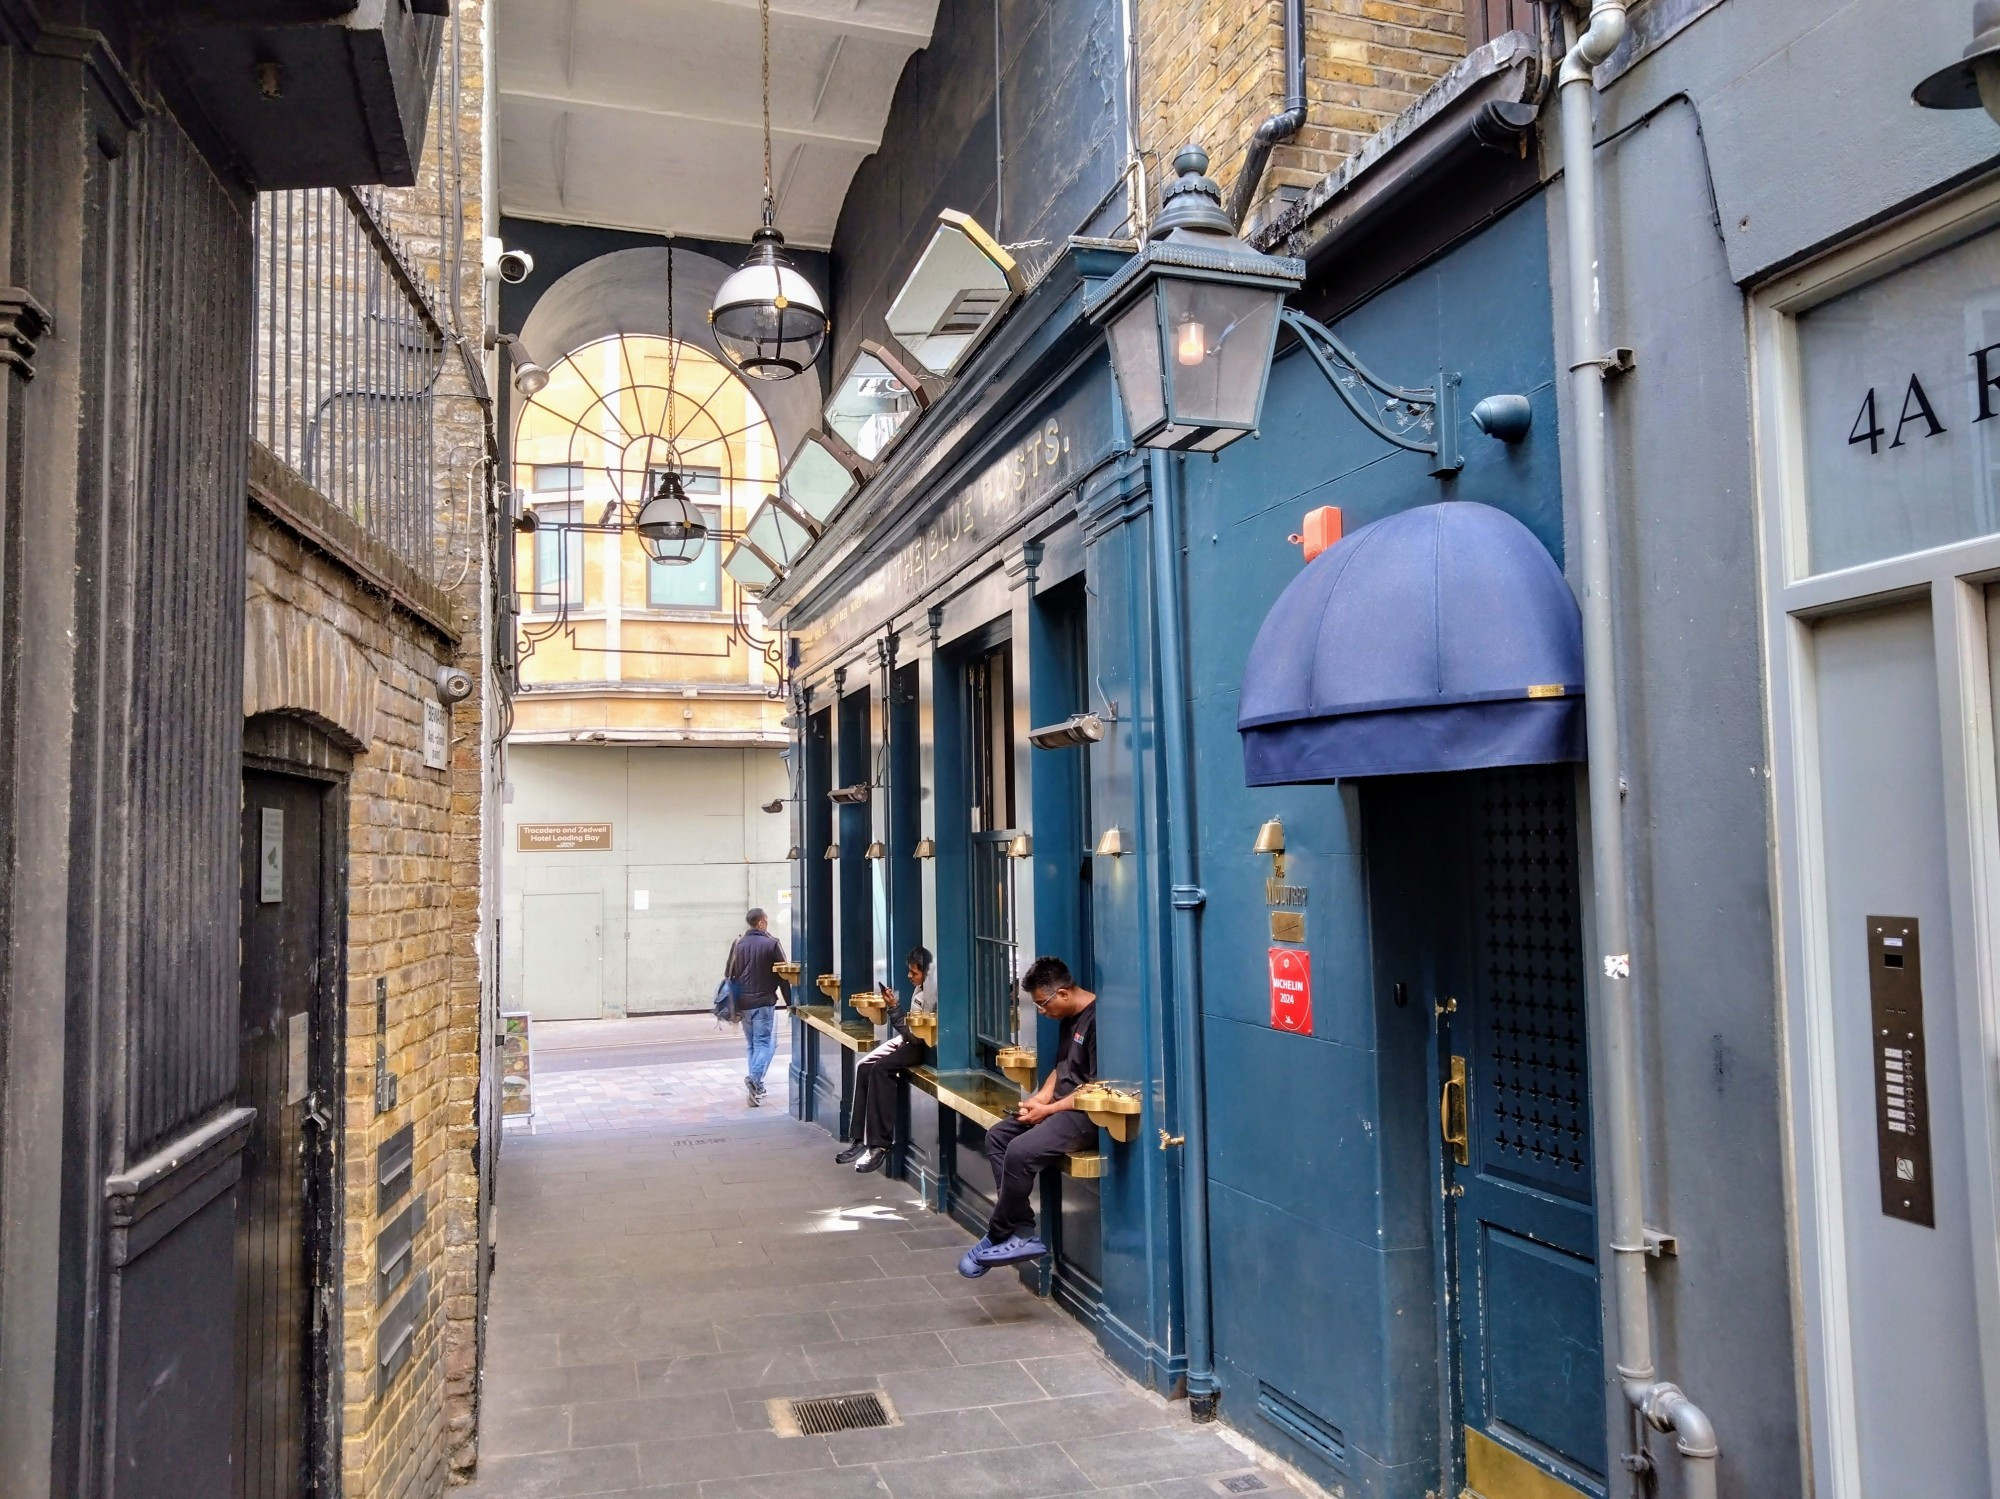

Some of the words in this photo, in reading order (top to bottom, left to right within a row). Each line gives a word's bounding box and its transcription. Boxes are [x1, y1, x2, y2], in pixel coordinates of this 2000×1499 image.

[1848, 372, 1948, 455] 4A
[894, 535, 924, 587] THE
[929, 496, 975, 562] BLUE
[523, 826, 561, 835] Trocadero
[562, 826, 577, 834] and
[578, 826, 607, 834] Zedwell
[530, 834, 551, 842] Hotel
[553, 834, 583, 843] Loading
[584, 834, 600, 843] Bay
[1273, 977, 1304, 992] MICHELIN
[1279, 992, 1295, 1005] 2024
